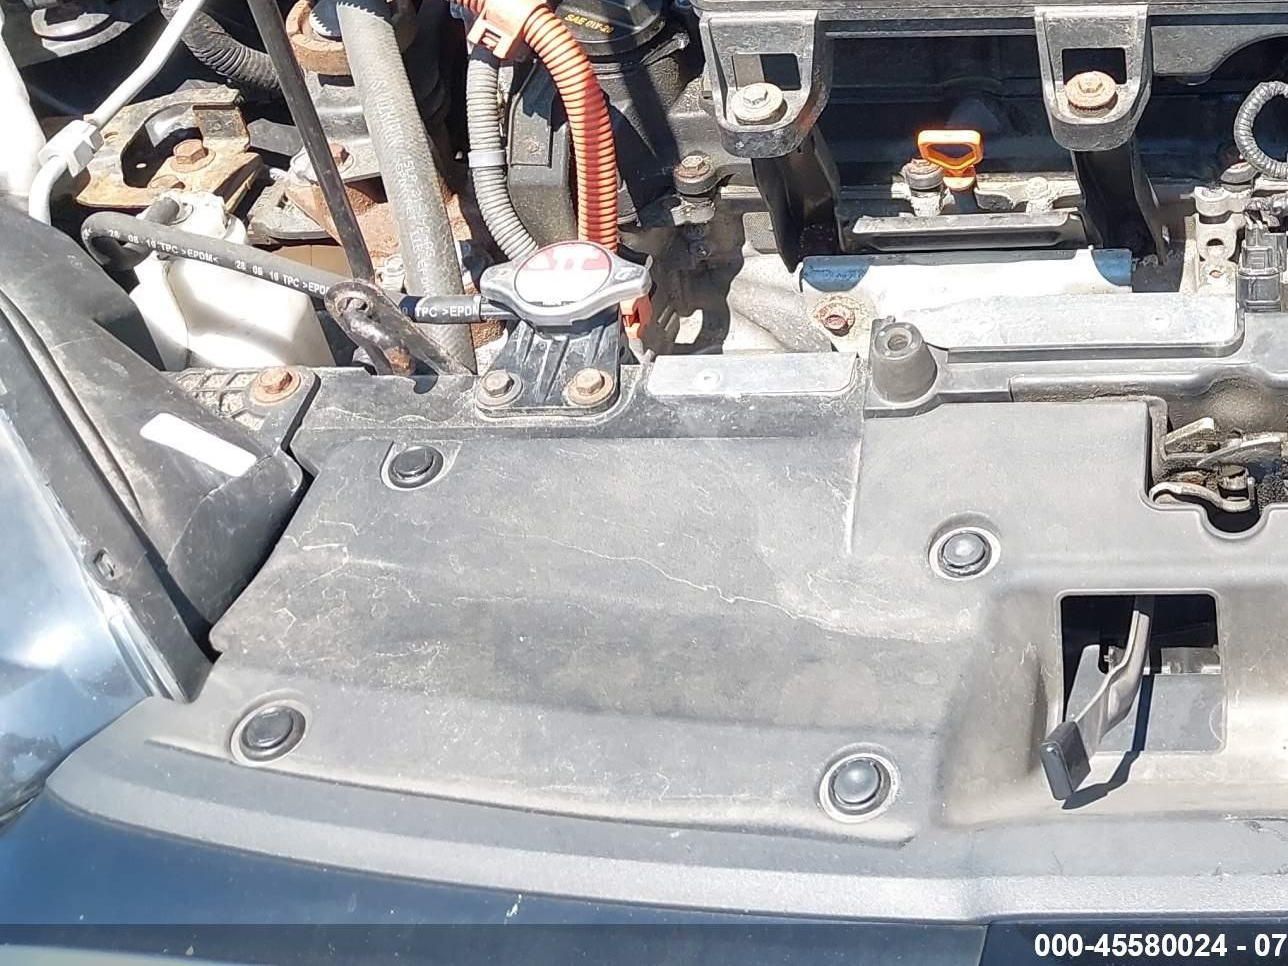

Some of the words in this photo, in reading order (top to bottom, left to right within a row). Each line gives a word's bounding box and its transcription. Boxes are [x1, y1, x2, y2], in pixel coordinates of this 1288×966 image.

[564, 13, 587, 26] SAE
[159, 242, 179, 253] TPC
[282, 274, 300, 287] TPC
[414, 306, 438, 317] TPC
